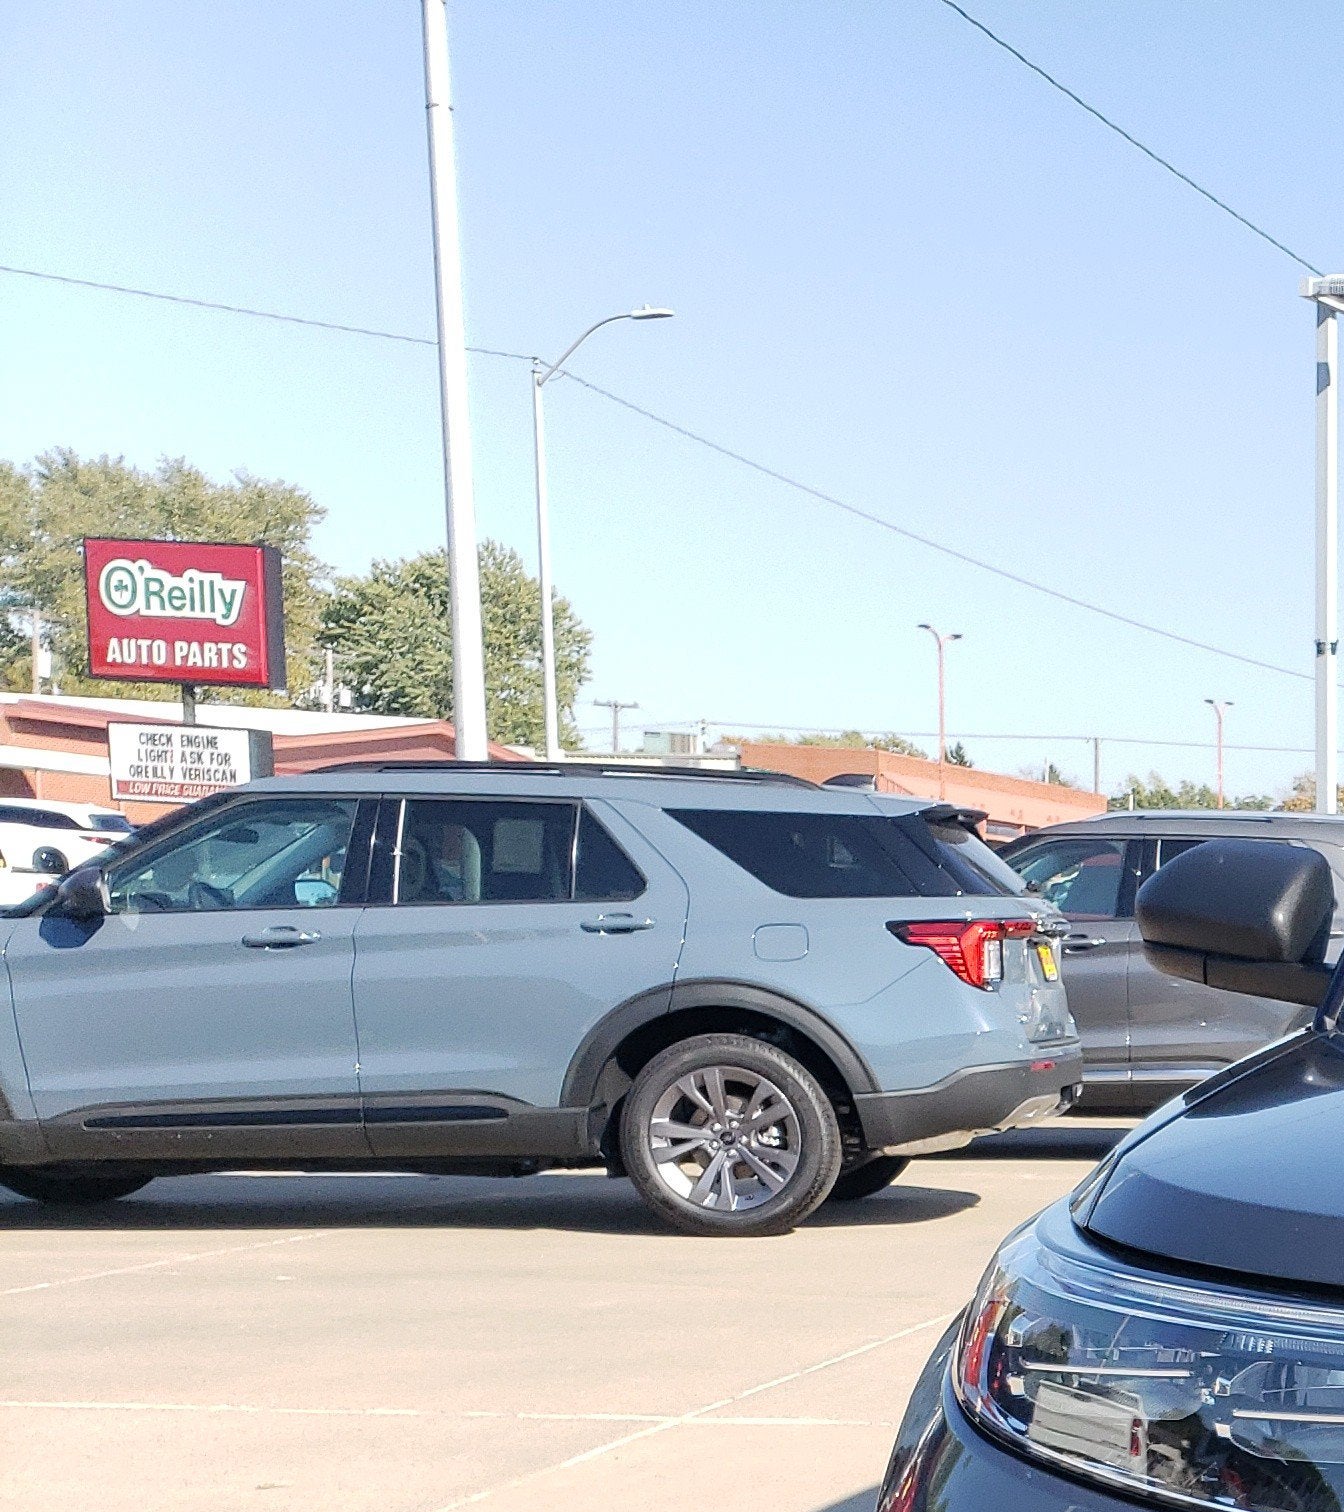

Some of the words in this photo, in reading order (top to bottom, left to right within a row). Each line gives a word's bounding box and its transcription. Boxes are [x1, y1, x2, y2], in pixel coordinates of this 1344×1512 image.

[104, 565, 238, 620] O'Reilly
[106, 637, 167, 665] AUTO
[174, 640, 248, 669] PARTS
[138, 732, 173, 746] CHECK
[180, 735, 218, 750] ENGINE
[180, 752, 204, 765] ASK
[209, 752, 232, 766] FOR
[129, 765, 174, 780] OREILLY
[181, 766, 237, 783] VERISCAN
[128, 780, 150, 793] LOW
[151, 781, 181, 795] PRICE
